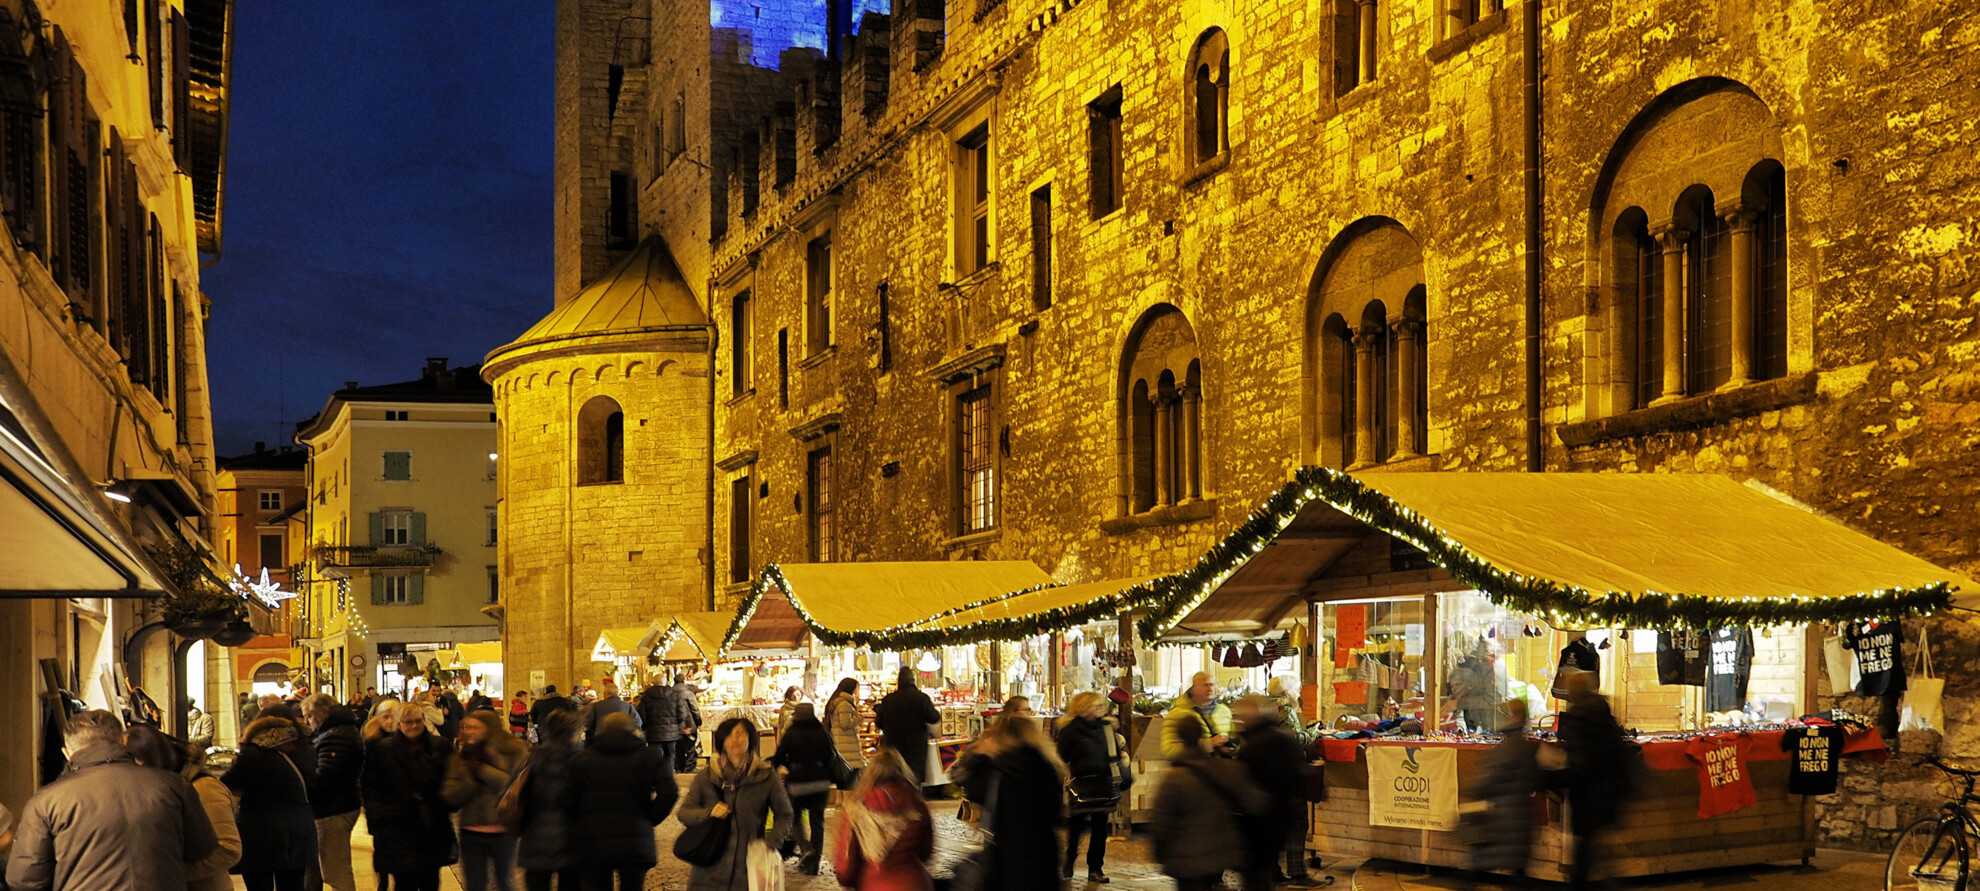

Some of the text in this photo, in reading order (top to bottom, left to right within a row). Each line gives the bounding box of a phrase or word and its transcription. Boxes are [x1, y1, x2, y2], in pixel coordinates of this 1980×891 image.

[1858, 633, 1894, 650] IO NON
[1859, 645, 1893, 662] ME NE
[1713, 662, 1735, 675] FREG
[1860, 658, 1894, 675] FREGO
[1799, 736, 1830, 749] IO NON
[1705, 744, 1737, 763] IO NON
[1799, 748, 1829, 761] ME NE
[1707, 757, 1738, 776] ME NE
[1799, 760, 1829, 773] FREGO
[1394, 776, 1430, 796] COOPI
[1710, 768, 1740, 788] FREGO
[1394, 795, 1430, 804] COOPERAZIONE
[1394, 802, 1430, 810] INTERNAZIONALE
